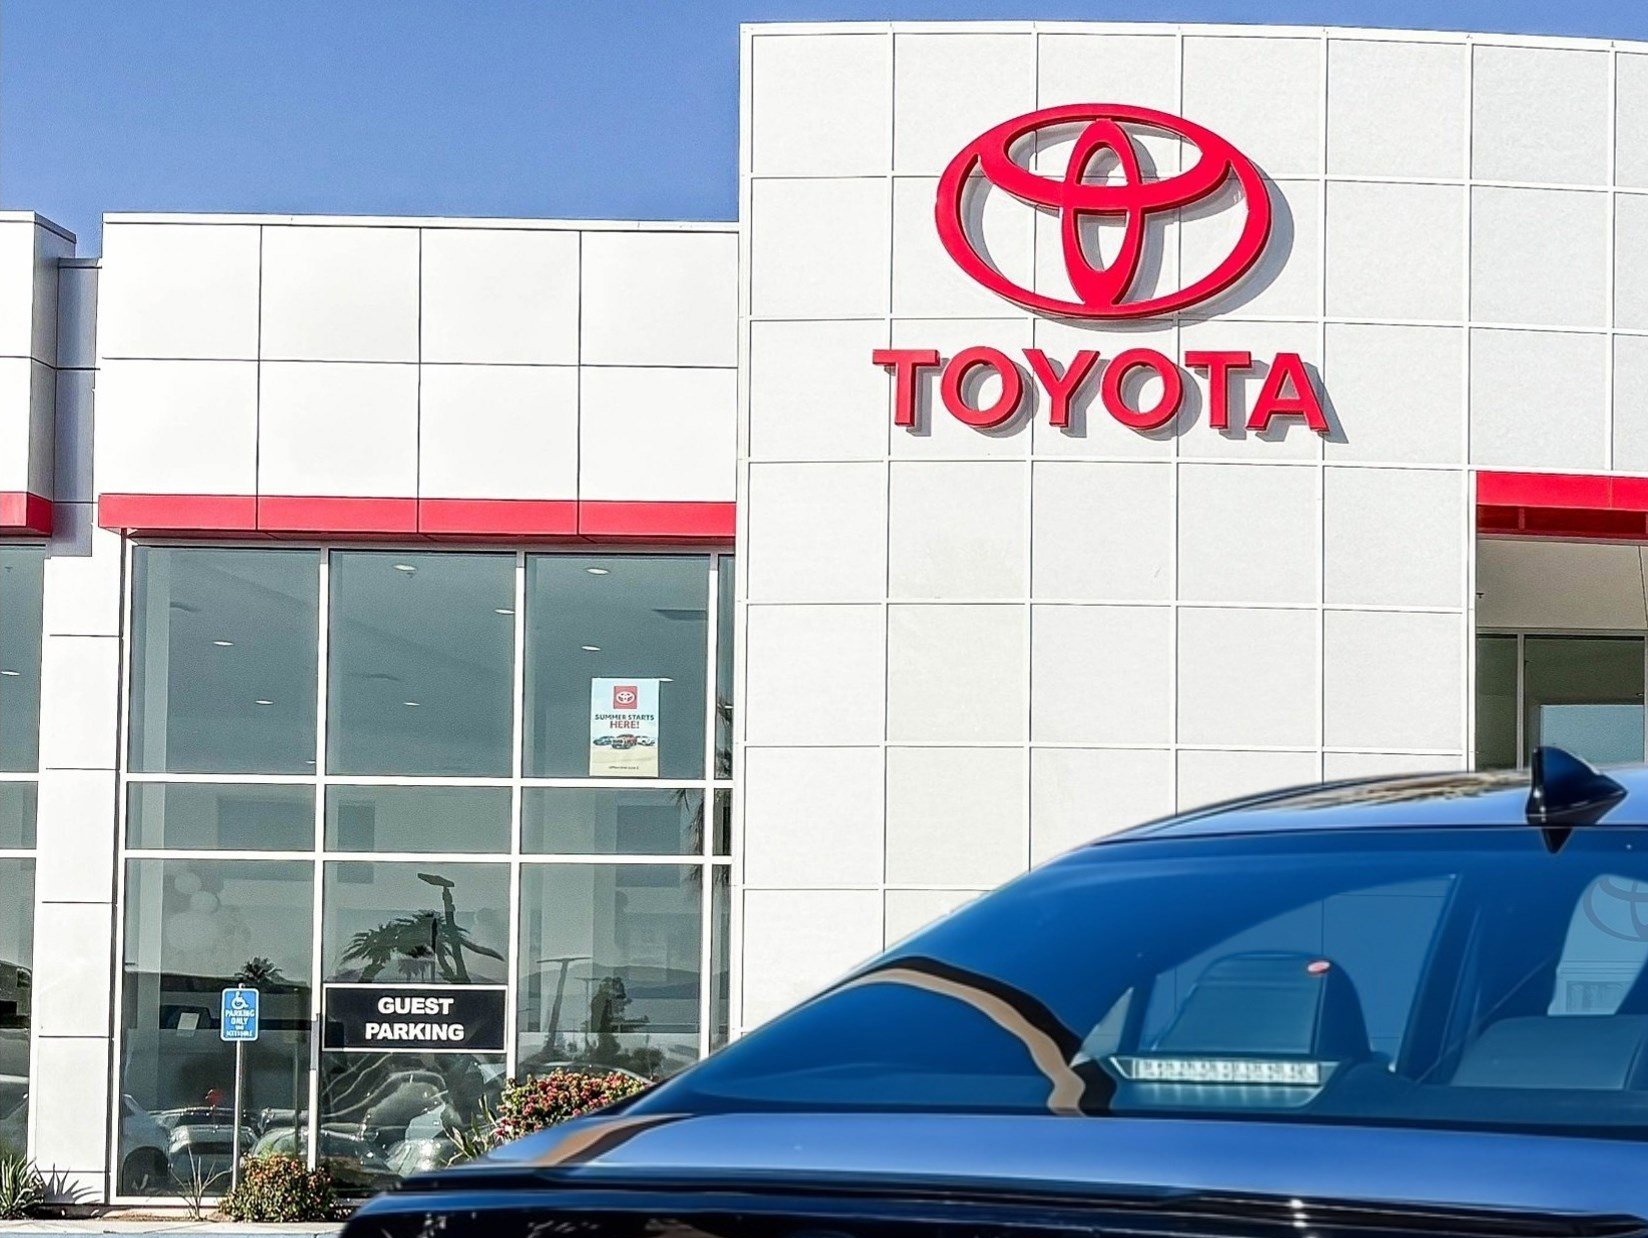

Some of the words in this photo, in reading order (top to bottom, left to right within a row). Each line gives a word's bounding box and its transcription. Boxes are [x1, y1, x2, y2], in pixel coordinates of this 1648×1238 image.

[872, 346, 1330, 431] TOYOTA
[609, 720, 640, 729] HERE!
[225, 1009, 256, 1018] PARKING
[377, 996, 455, 1015] GUEST
[364, 1022, 465, 1041] PARKING
